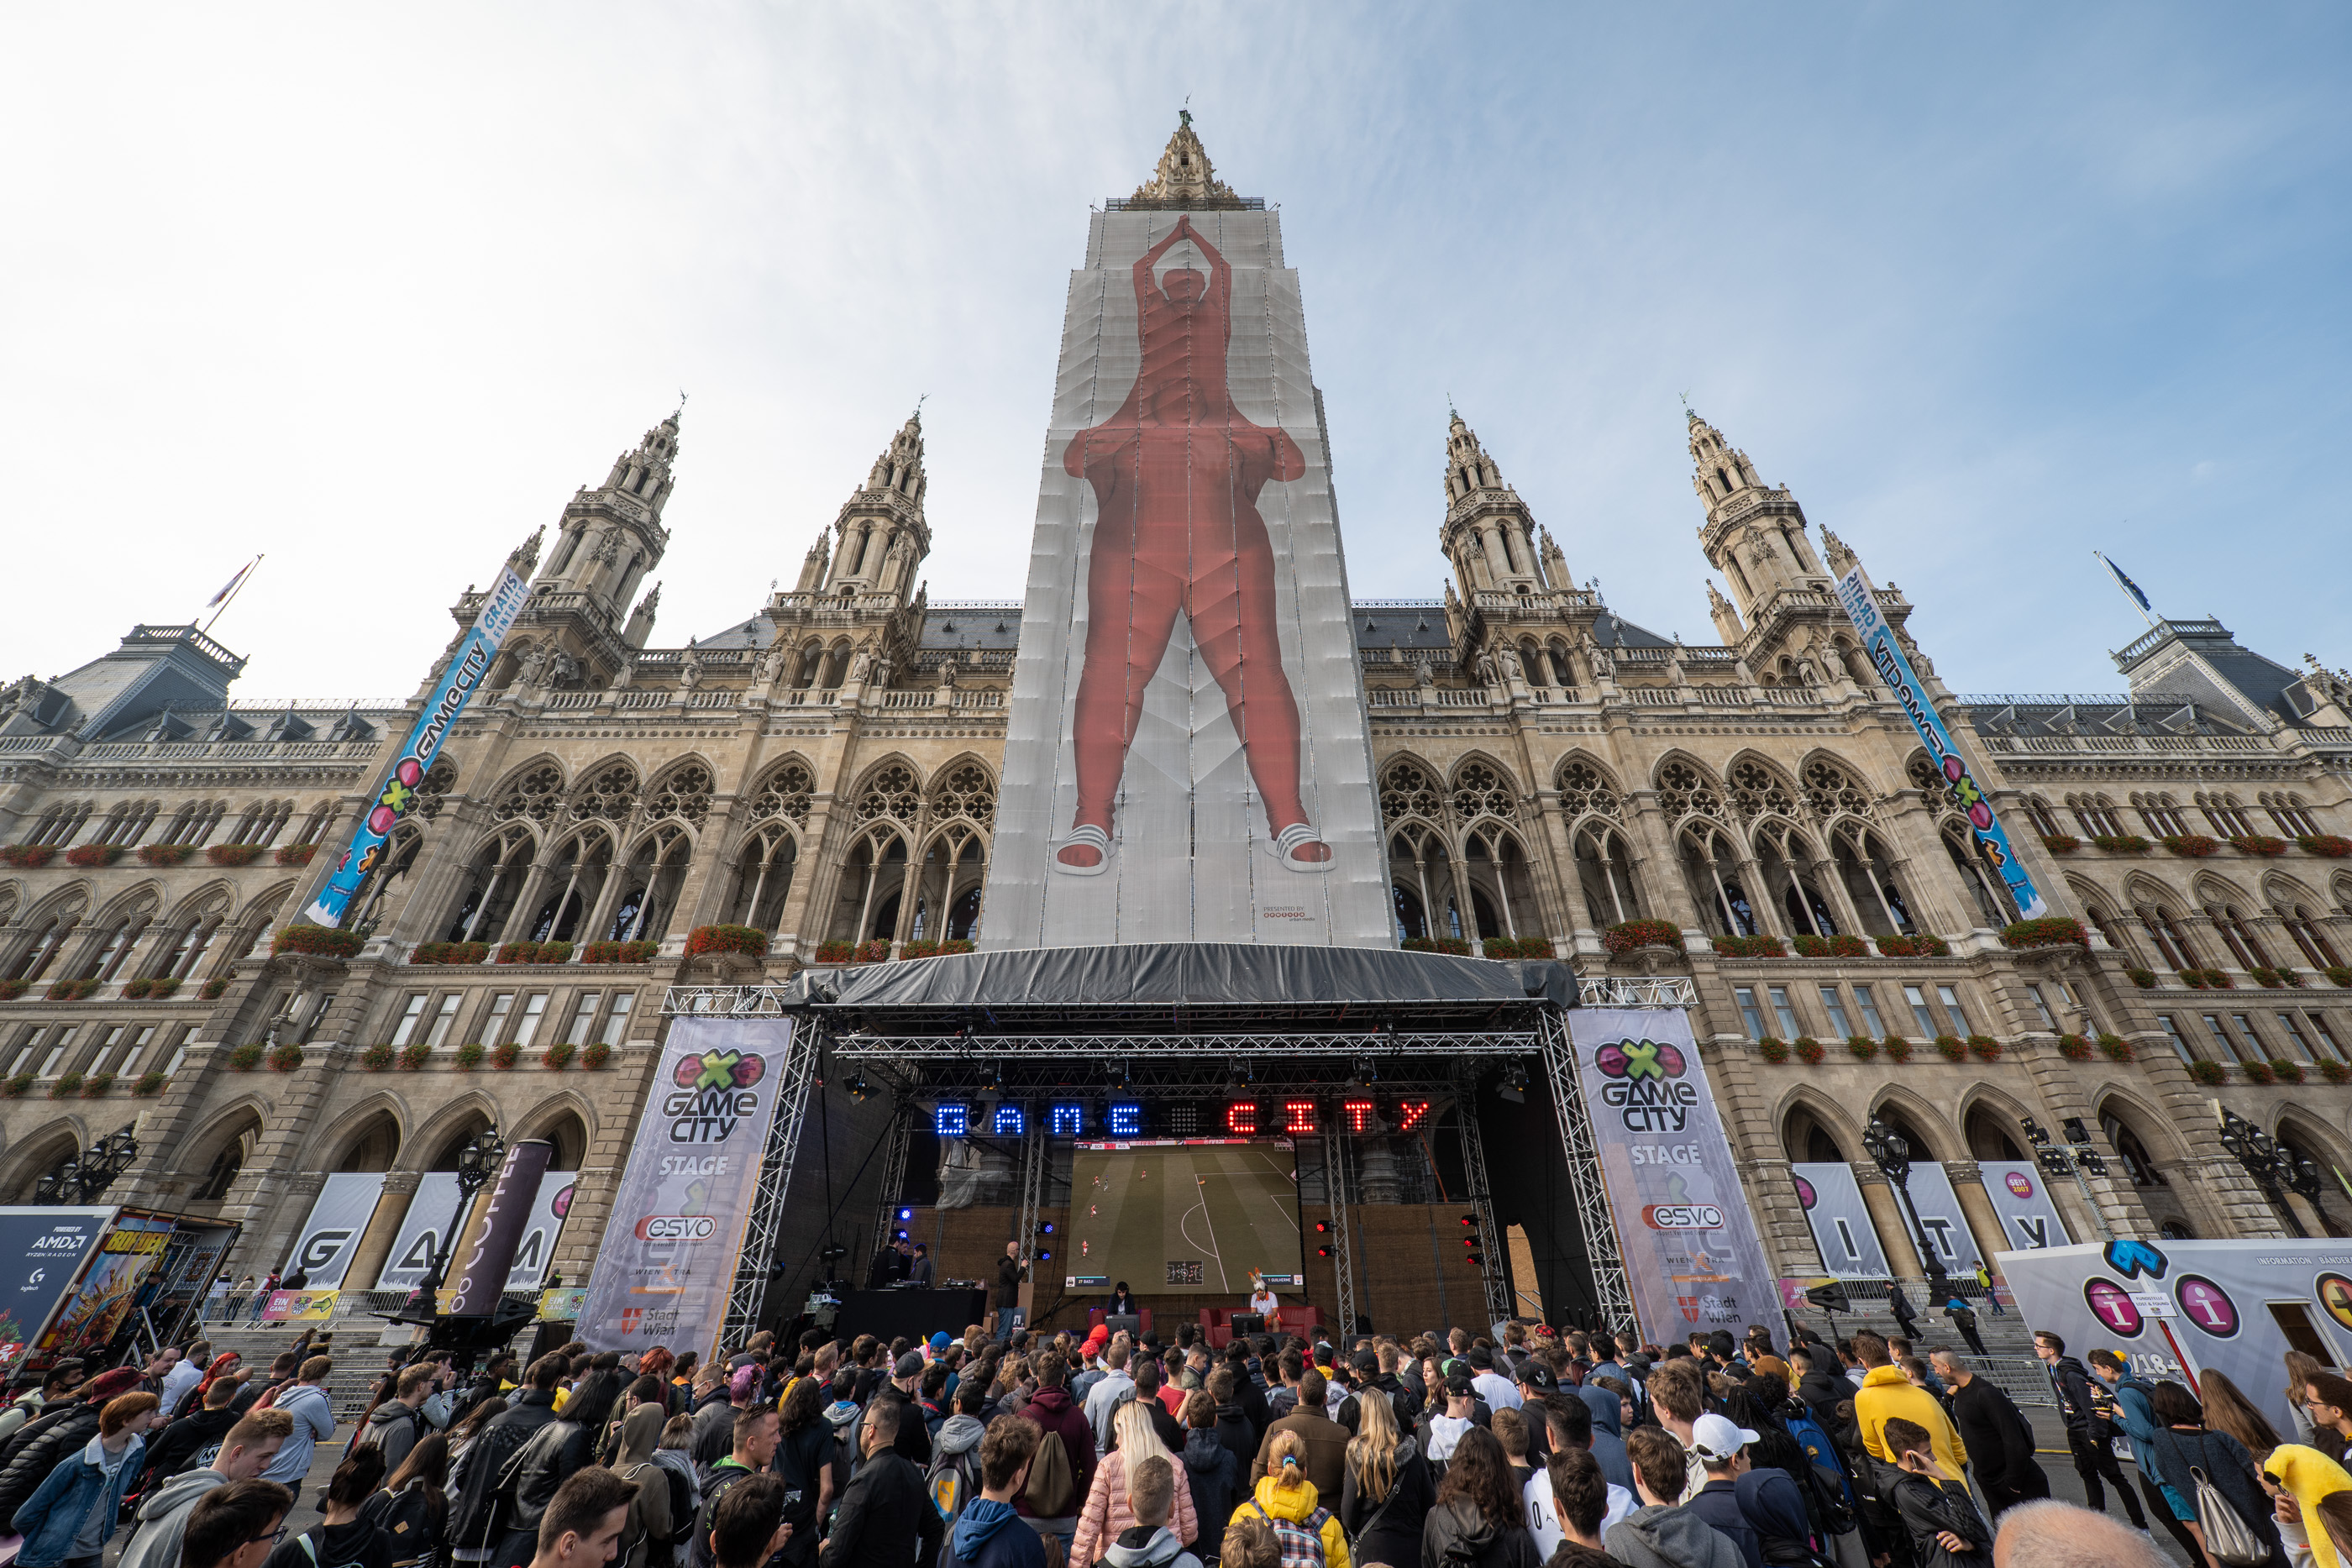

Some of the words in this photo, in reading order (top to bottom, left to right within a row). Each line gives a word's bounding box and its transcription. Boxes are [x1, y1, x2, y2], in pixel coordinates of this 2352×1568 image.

[484, 574, 517, 629] GRATIS
[493, 585, 526, 639] EINTRITT
[1622, 1106, 1687, 1132] CITY
[669, 1117, 739, 1143] CITY
[1630, 1145, 1702, 1165] STAGE
[659, 1156, 729, 1176] STAGE
[31, 1235, 73, 1249] AMD
[2255, 1256, 2313, 1265] INFORMATION
[273, 1298, 290, 1306] EIN
[548, 1296, 564, 1304] EIN
[1703, 1296, 1737, 1308] Stadt
[646, 1308, 680, 1321] Stadt
[1704, 1309, 1742, 1324] Wien
[643, 1322, 675, 1335] Wien
